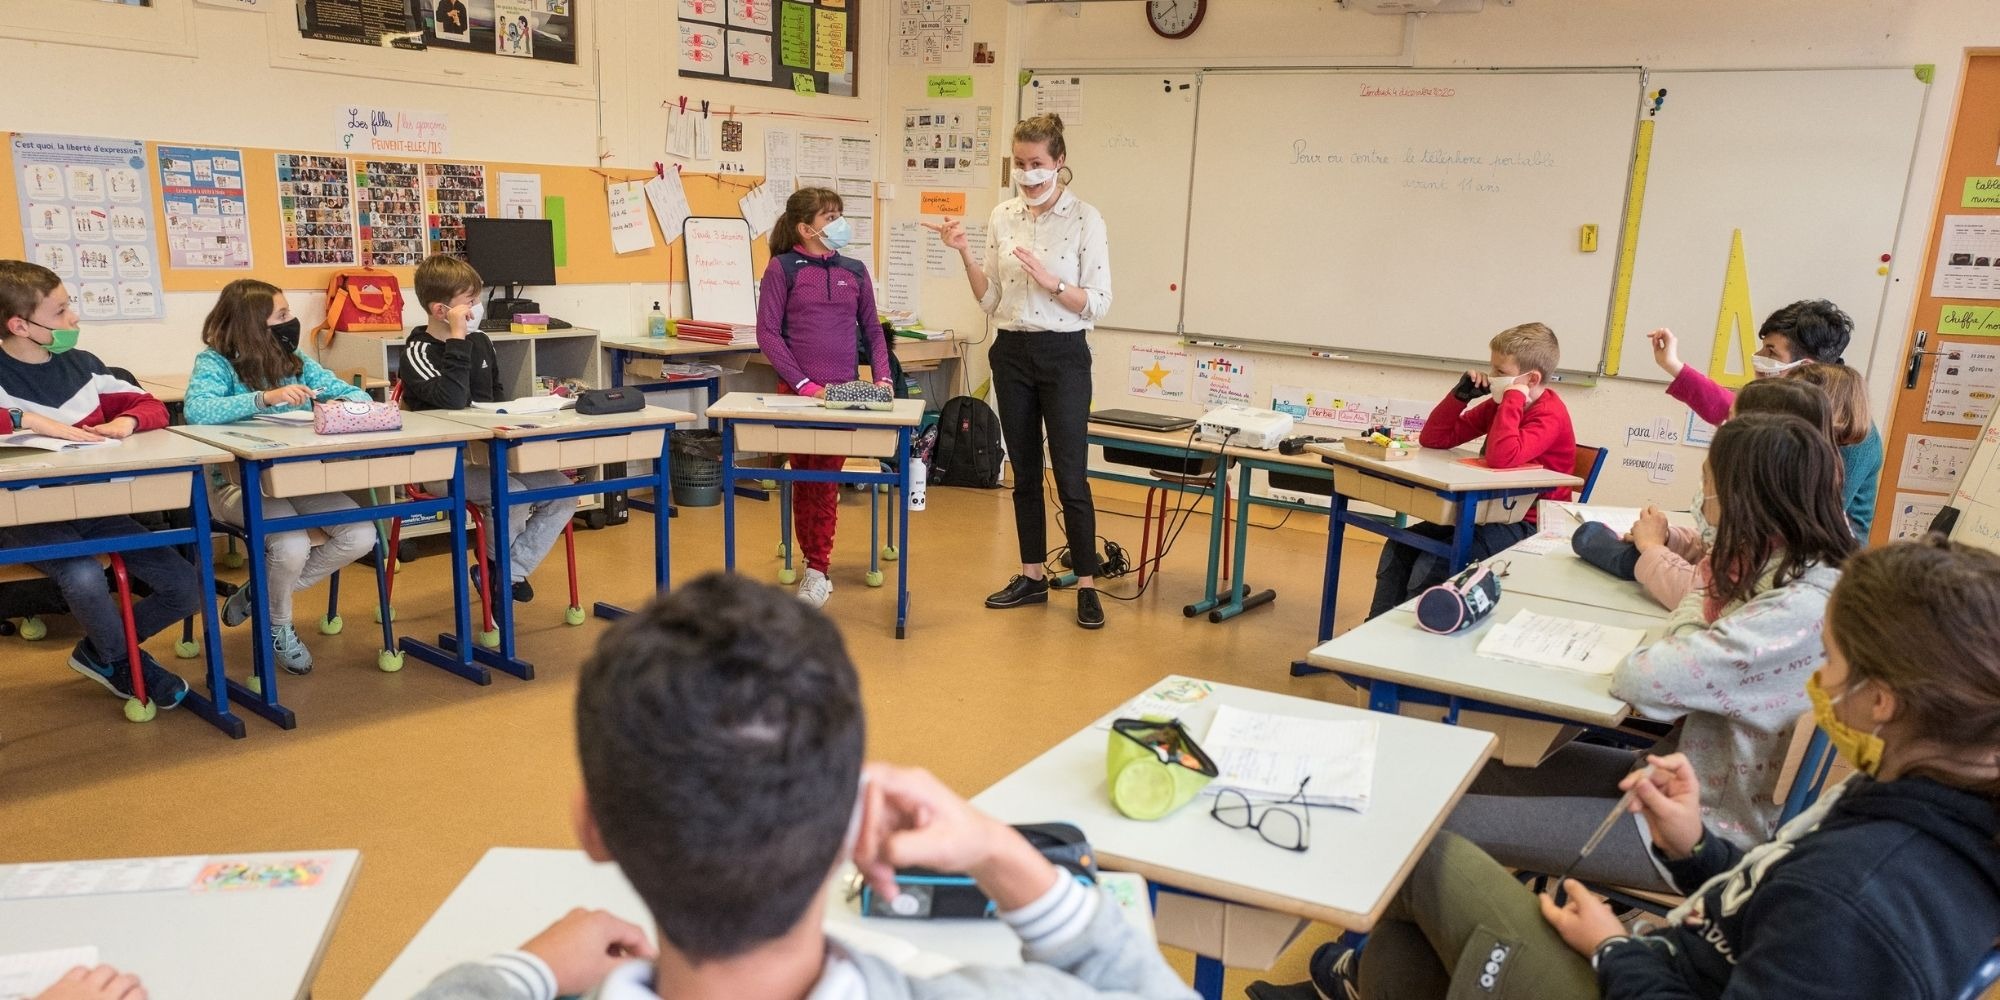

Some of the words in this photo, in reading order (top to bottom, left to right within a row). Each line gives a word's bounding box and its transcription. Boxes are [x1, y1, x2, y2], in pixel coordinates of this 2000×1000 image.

[347, 108, 369, 129] Les
[371, 109, 393, 136] filles
[14, 140, 34, 149] C'est
[36, 143, 54, 151] quoi
[66, 143, 92, 152] liberté
[1289, 138, 1321, 165] Pour
[1327, 154, 1344, 164] ou
[1350, 148, 1390, 165] contre
[1400, 148, 1416, 164] le
[1420, 149, 1483, 170] téléphone
[1489, 150, 1557, 175] portable
[1458, 177, 1473, 192] 11
[1476, 182, 1503, 193] ans
[1311, 408, 1333, 418] Verbe
[1787, 655, 1813, 672] NYC
[1739, 672, 1766, 687] NYC
